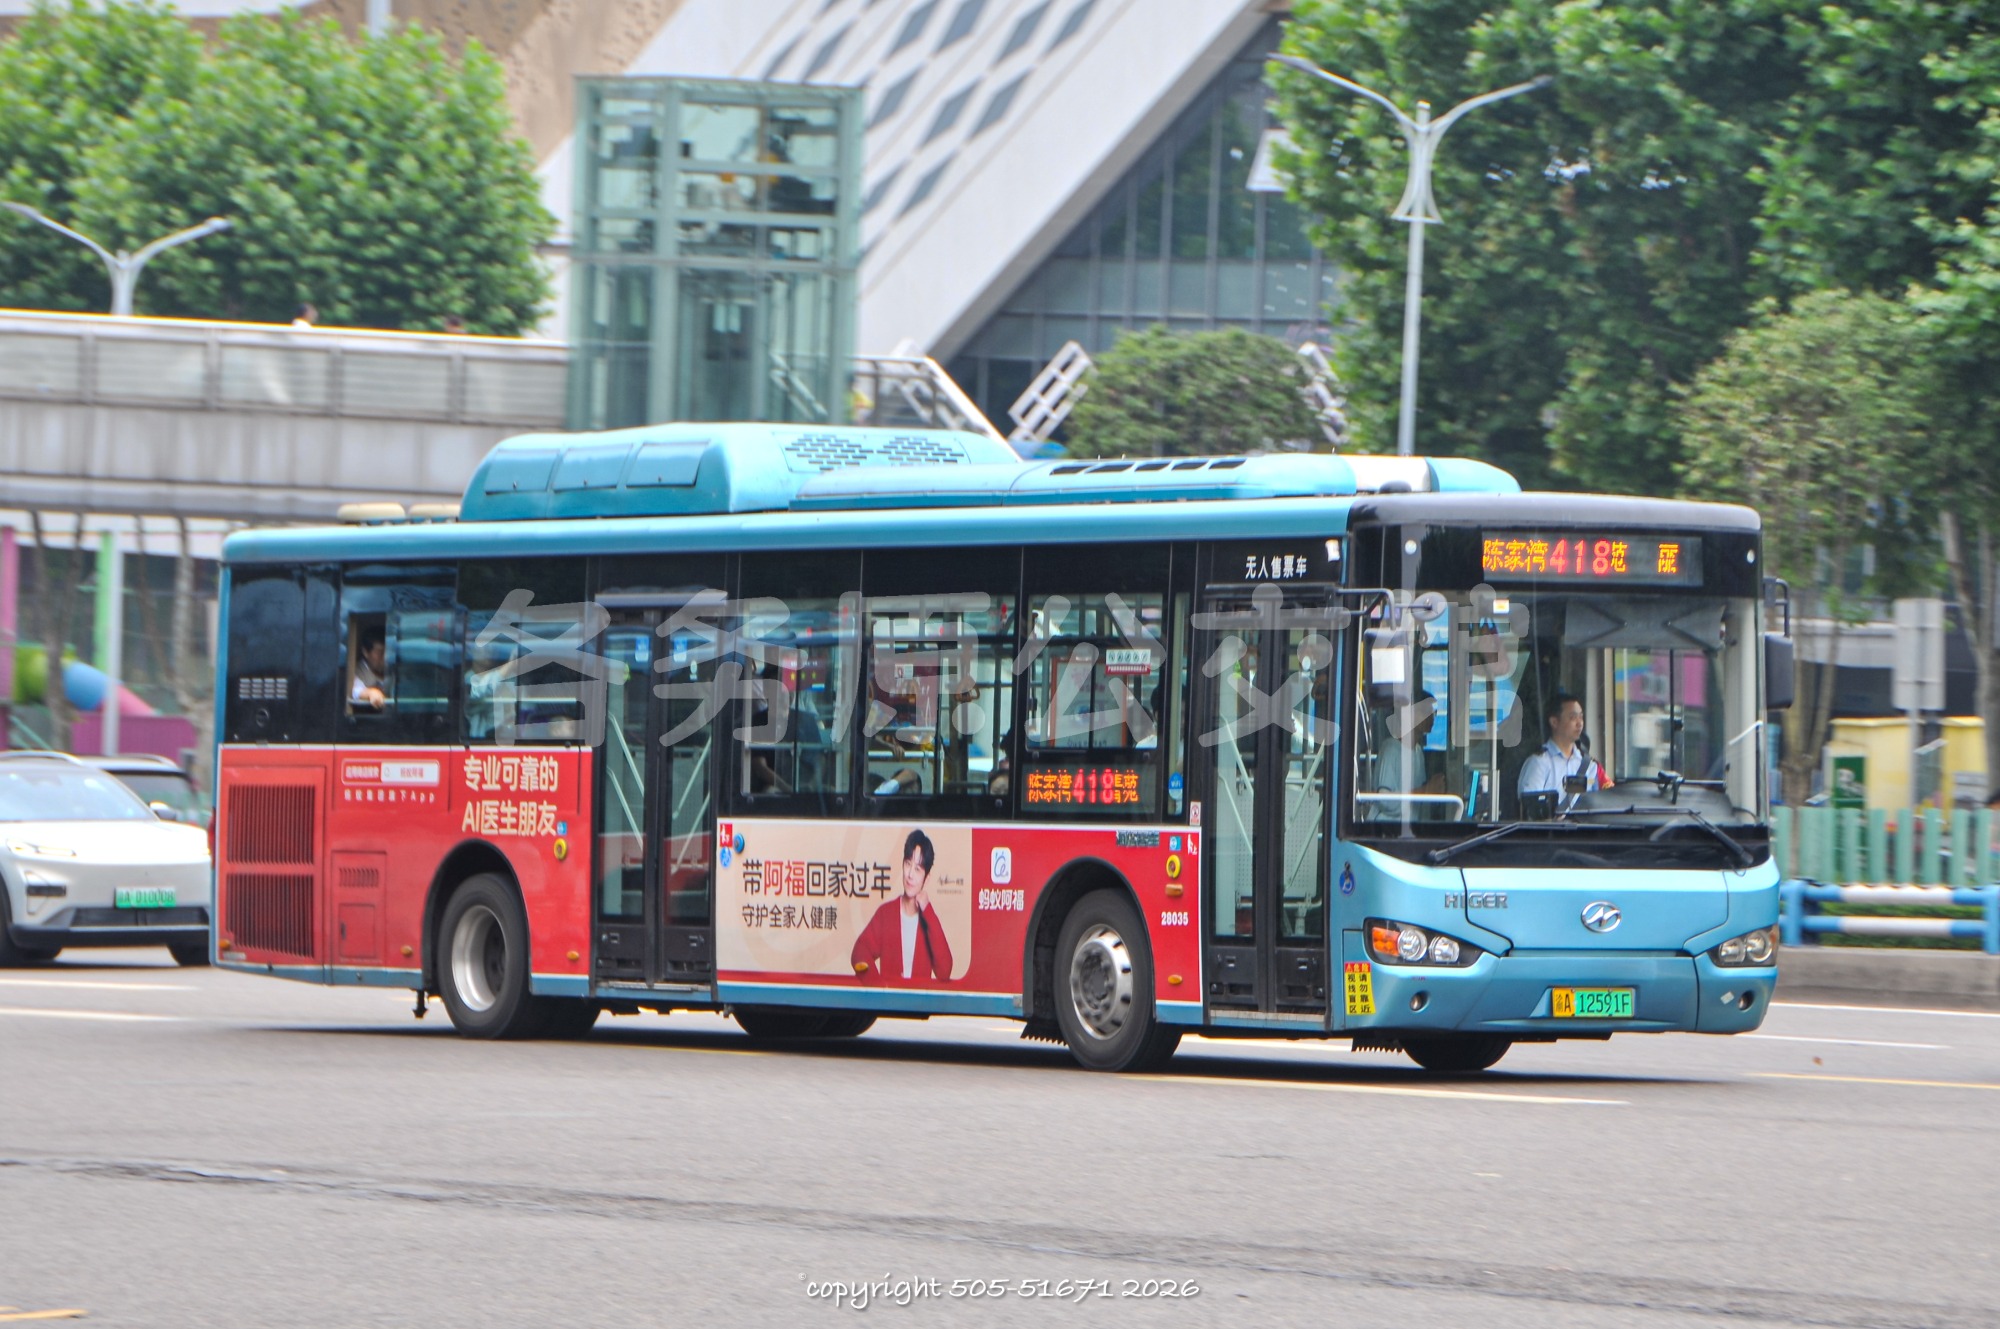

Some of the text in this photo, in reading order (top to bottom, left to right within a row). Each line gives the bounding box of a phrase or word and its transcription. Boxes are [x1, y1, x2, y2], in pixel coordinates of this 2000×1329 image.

[1245, 555, 1307, 579] 无人售票车
[463, 754, 559, 792] 专业可靠的
[461, 799, 558, 836] AI医生朋友
[742, 858, 892, 899] 带阿福回家过年
[978, 888, 1025, 911] 蚂蚁阿福
[1445, 892, 1508, 909] HIGER
[741, 904, 838, 930] 守护全家人健康
[1161, 911, 1189, 926] 28035
